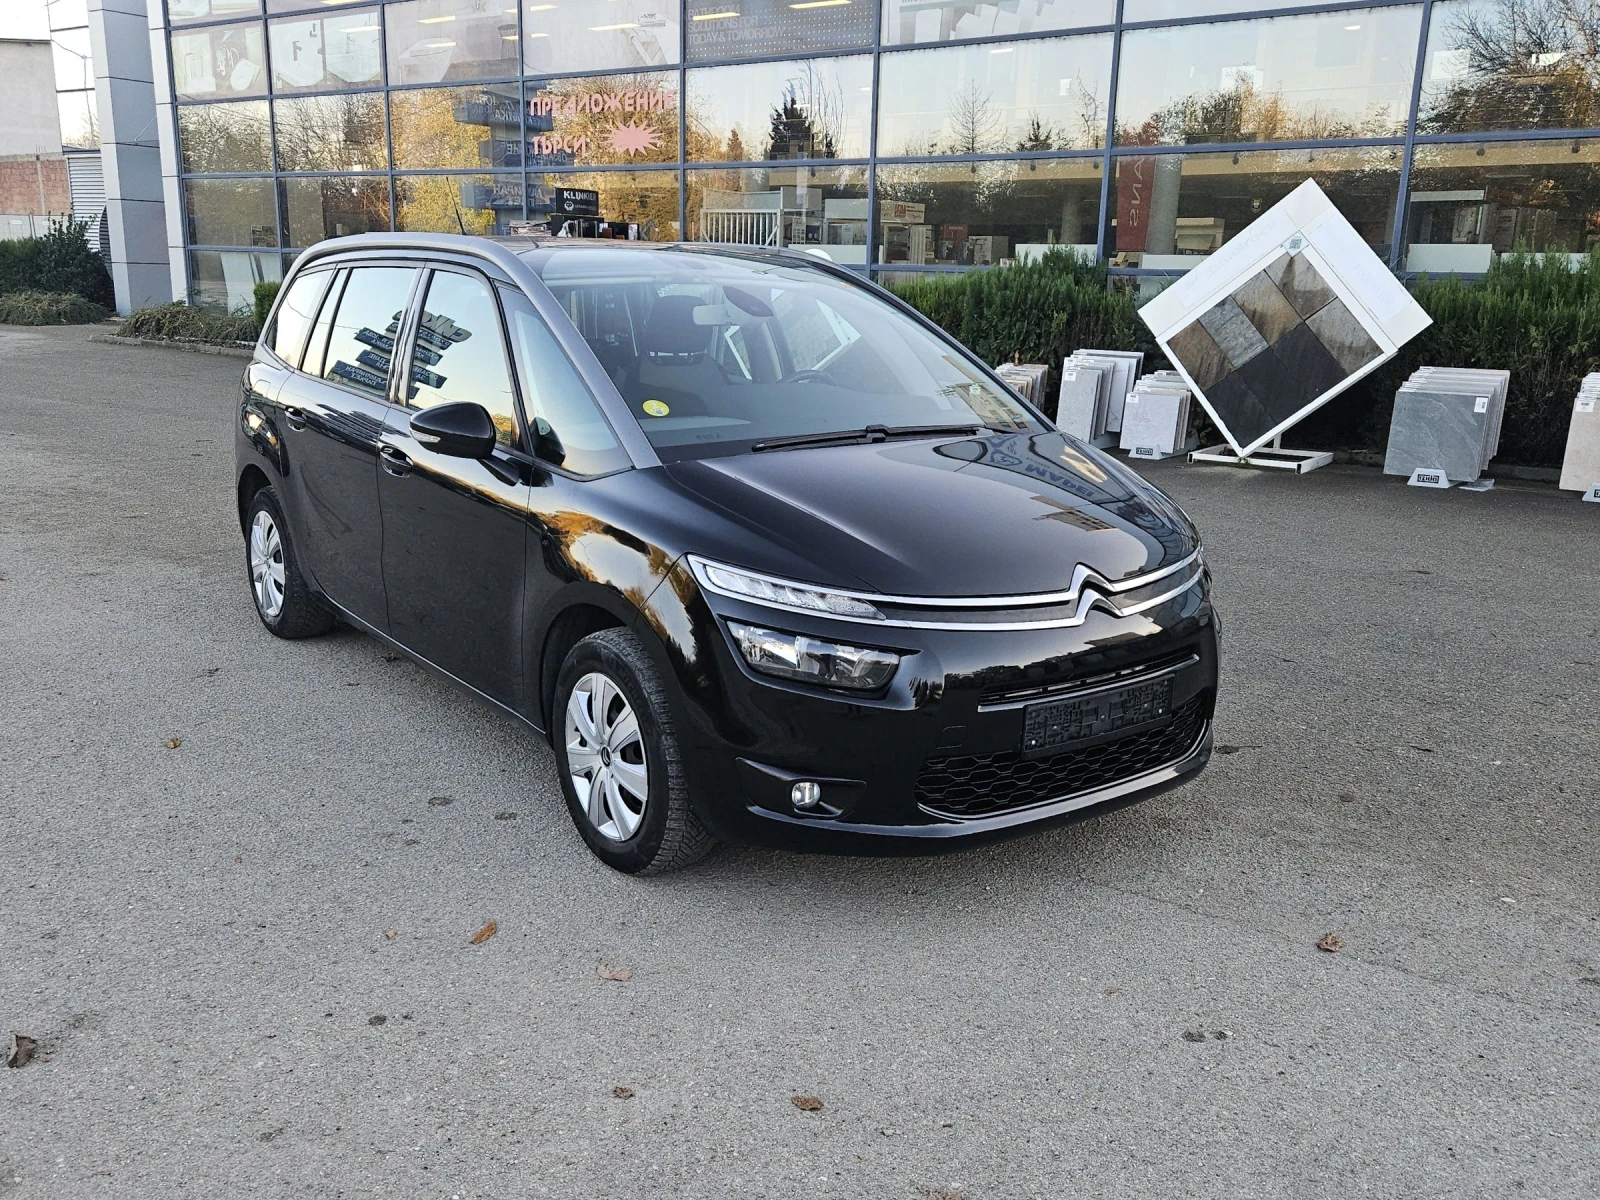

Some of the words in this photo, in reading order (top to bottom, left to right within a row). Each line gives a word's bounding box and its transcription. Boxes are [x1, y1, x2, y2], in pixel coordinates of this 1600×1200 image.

[687, 17, 738, 33] SOLUTIONS
[739, 16, 758, 27] FOR
[687, 32, 720, 45] TODAY
[727, 27, 784, 41] TOMORROW
[530, 90, 677, 116] ПРЕДЛОЖЕНИЕ
[532, 135, 587, 157] ТЪРСИ
